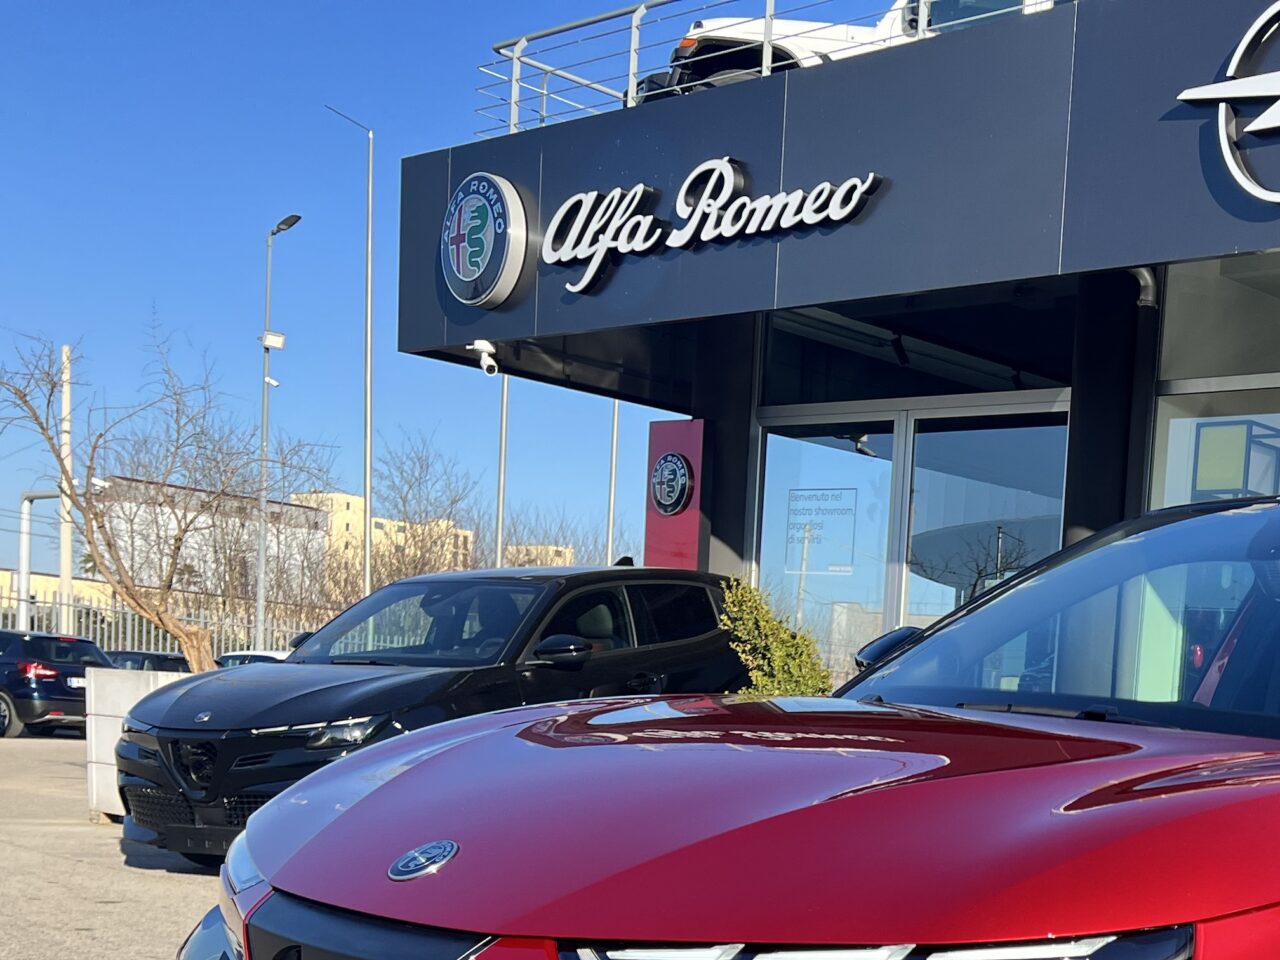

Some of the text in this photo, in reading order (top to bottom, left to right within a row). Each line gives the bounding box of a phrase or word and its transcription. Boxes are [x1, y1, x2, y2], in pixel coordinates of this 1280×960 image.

[470, 180, 505, 234] ROMEO
[542, 155, 875, 294] Alfa Romeo
